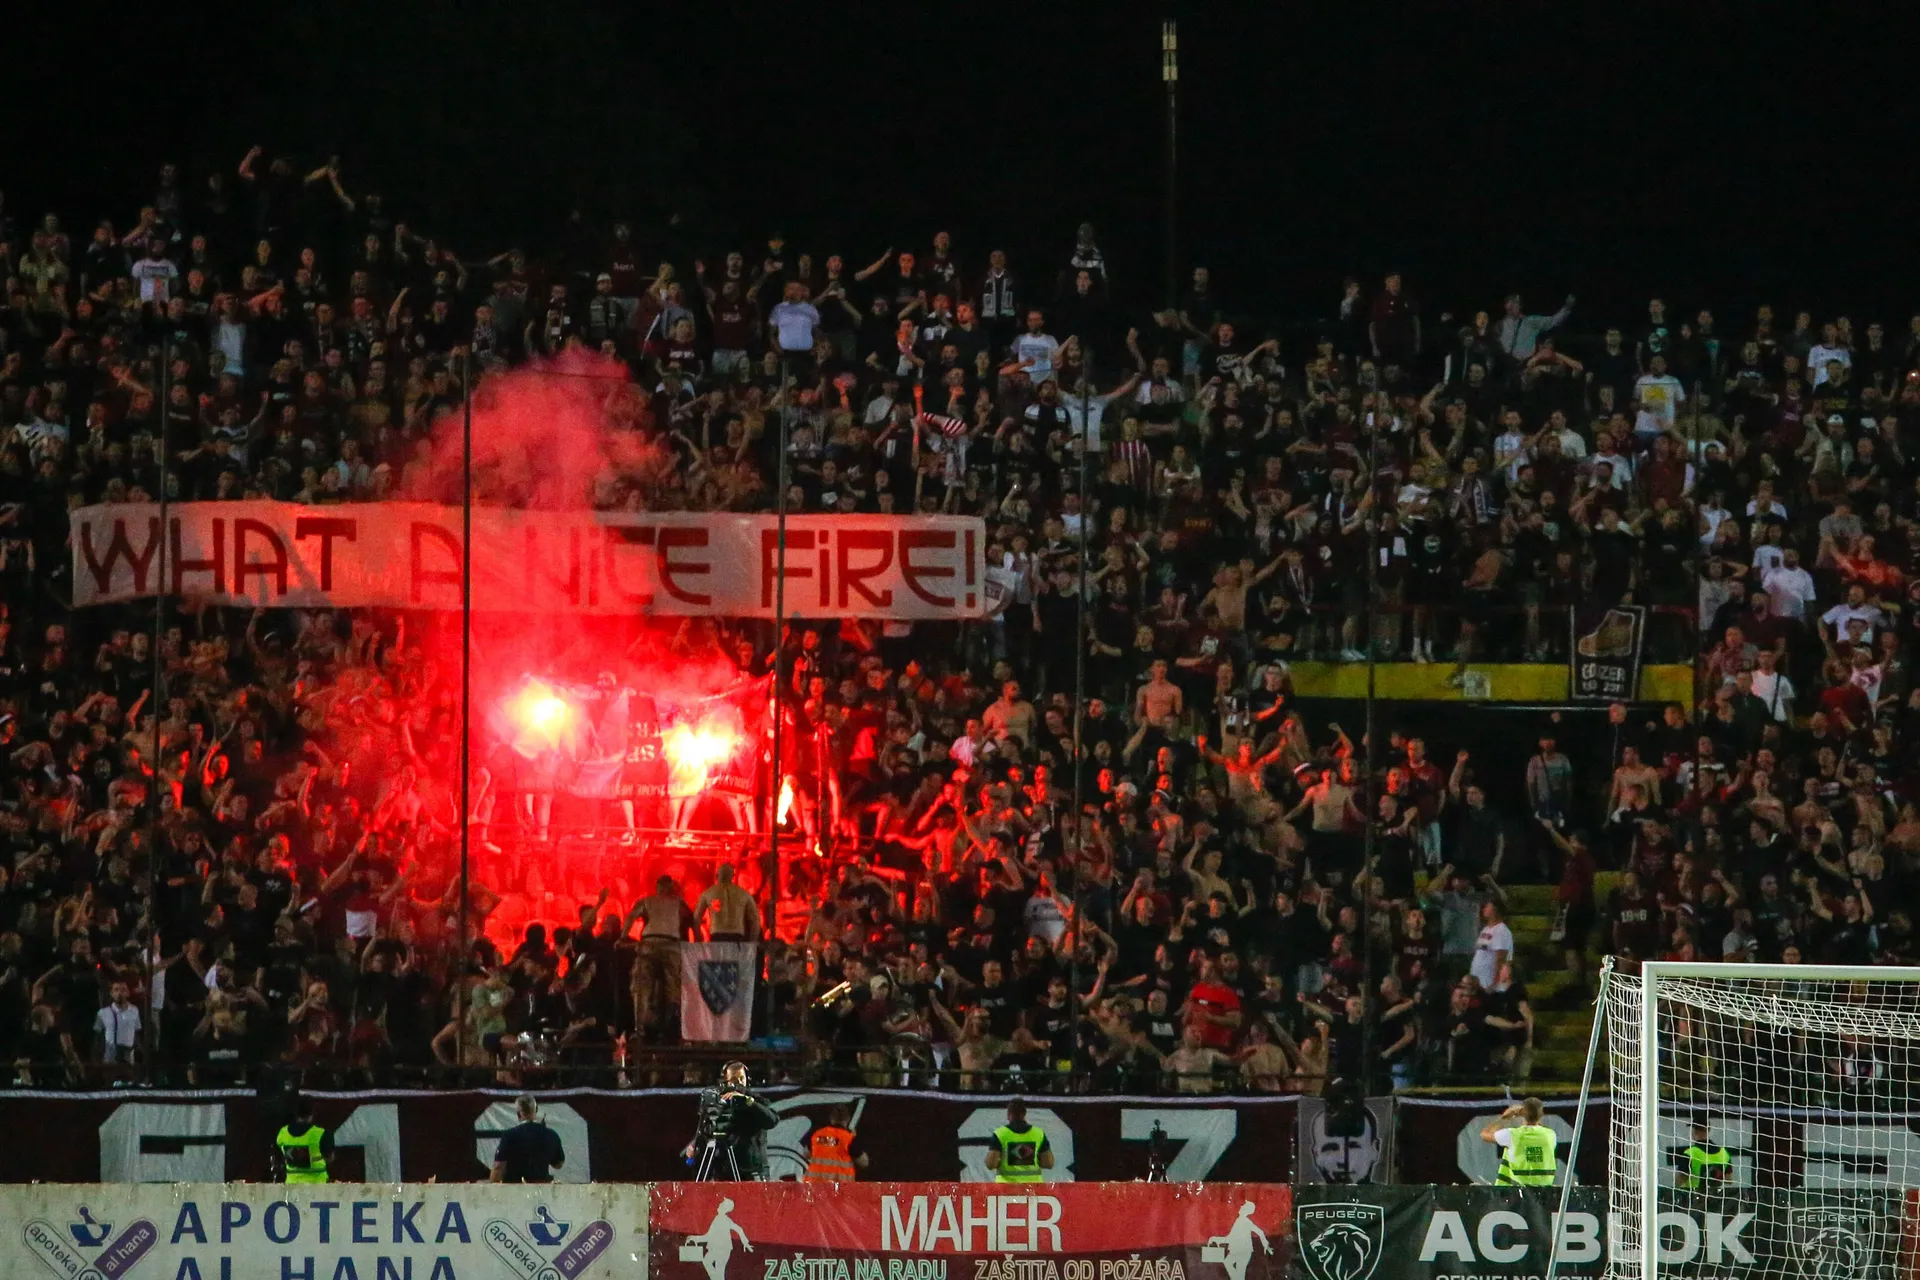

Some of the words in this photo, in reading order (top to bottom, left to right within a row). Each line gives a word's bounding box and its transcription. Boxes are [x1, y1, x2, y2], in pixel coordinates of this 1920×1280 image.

[80, 515, 357, 595] WHAT
[410, 520, 467, 603] A
[170, 1201, 472, 1244] APOTEKA
[881, 1195, 1063, 1252] MAHER
[1304, 1210, 1377, 1221] PEUGEOT
[1796, 1214, 1869, 1224] PEUGEOT
[30, 1225, 78, 1275] apoteka
[117, 1228, 150, 1260] hana
[490, 1224, 537, 1273] apoteka
[573, 1226, 606, 1258] hana
[1418, 1210, 1530, 1263] AC
[281, 1256, 457, 1280] HANA
[765, 1253, 848, 1280] ZAŠTITA
[855, 1259, 882, 1280] NA
[889, 1259, 946, 1280] RADU
[975, 1253, 1057, 1280] ZAŠTITA
[1063, 1259, 1094, 1280] OD
[1100, 1253, 1186, 1280] POŽARA
